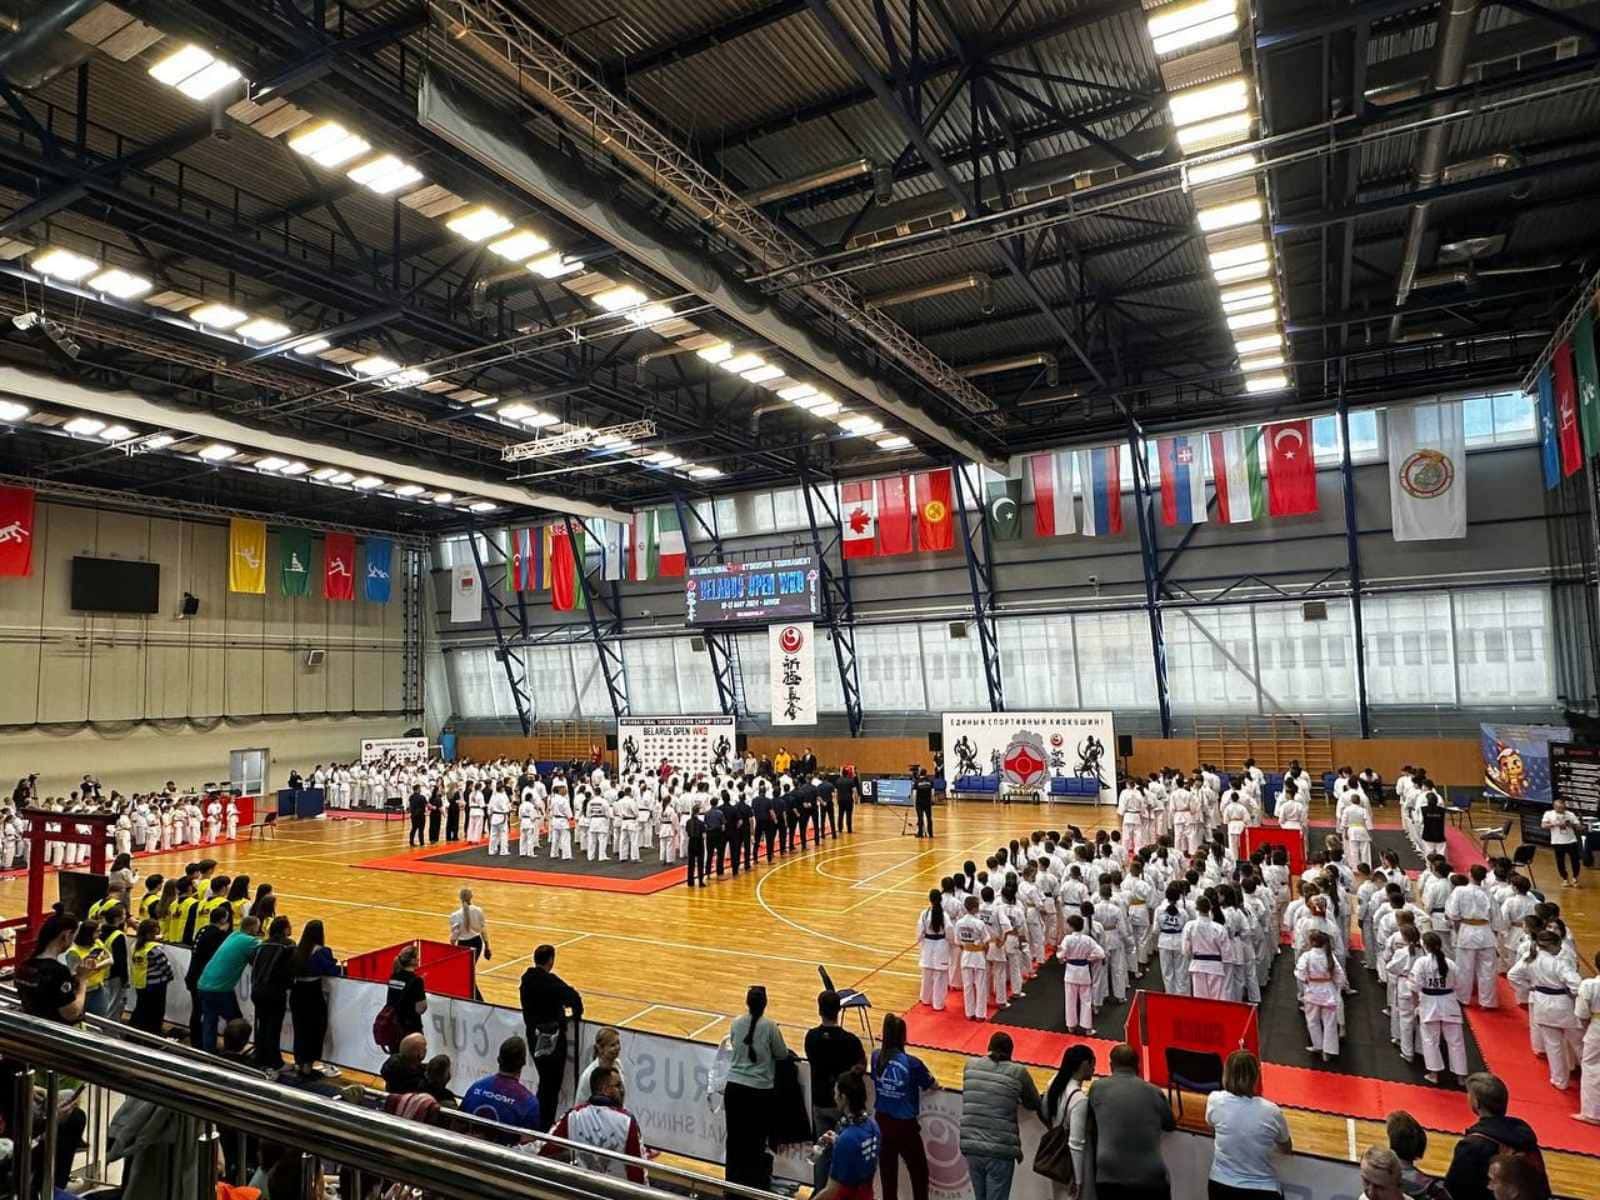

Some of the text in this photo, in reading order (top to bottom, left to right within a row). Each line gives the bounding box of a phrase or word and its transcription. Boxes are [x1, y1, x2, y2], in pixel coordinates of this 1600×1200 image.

[747, 573, 775, 596] OPEN
[778, 571, 805, 594] WKO
[643, 727, 708, 736] BELARUS OPEN WKO
